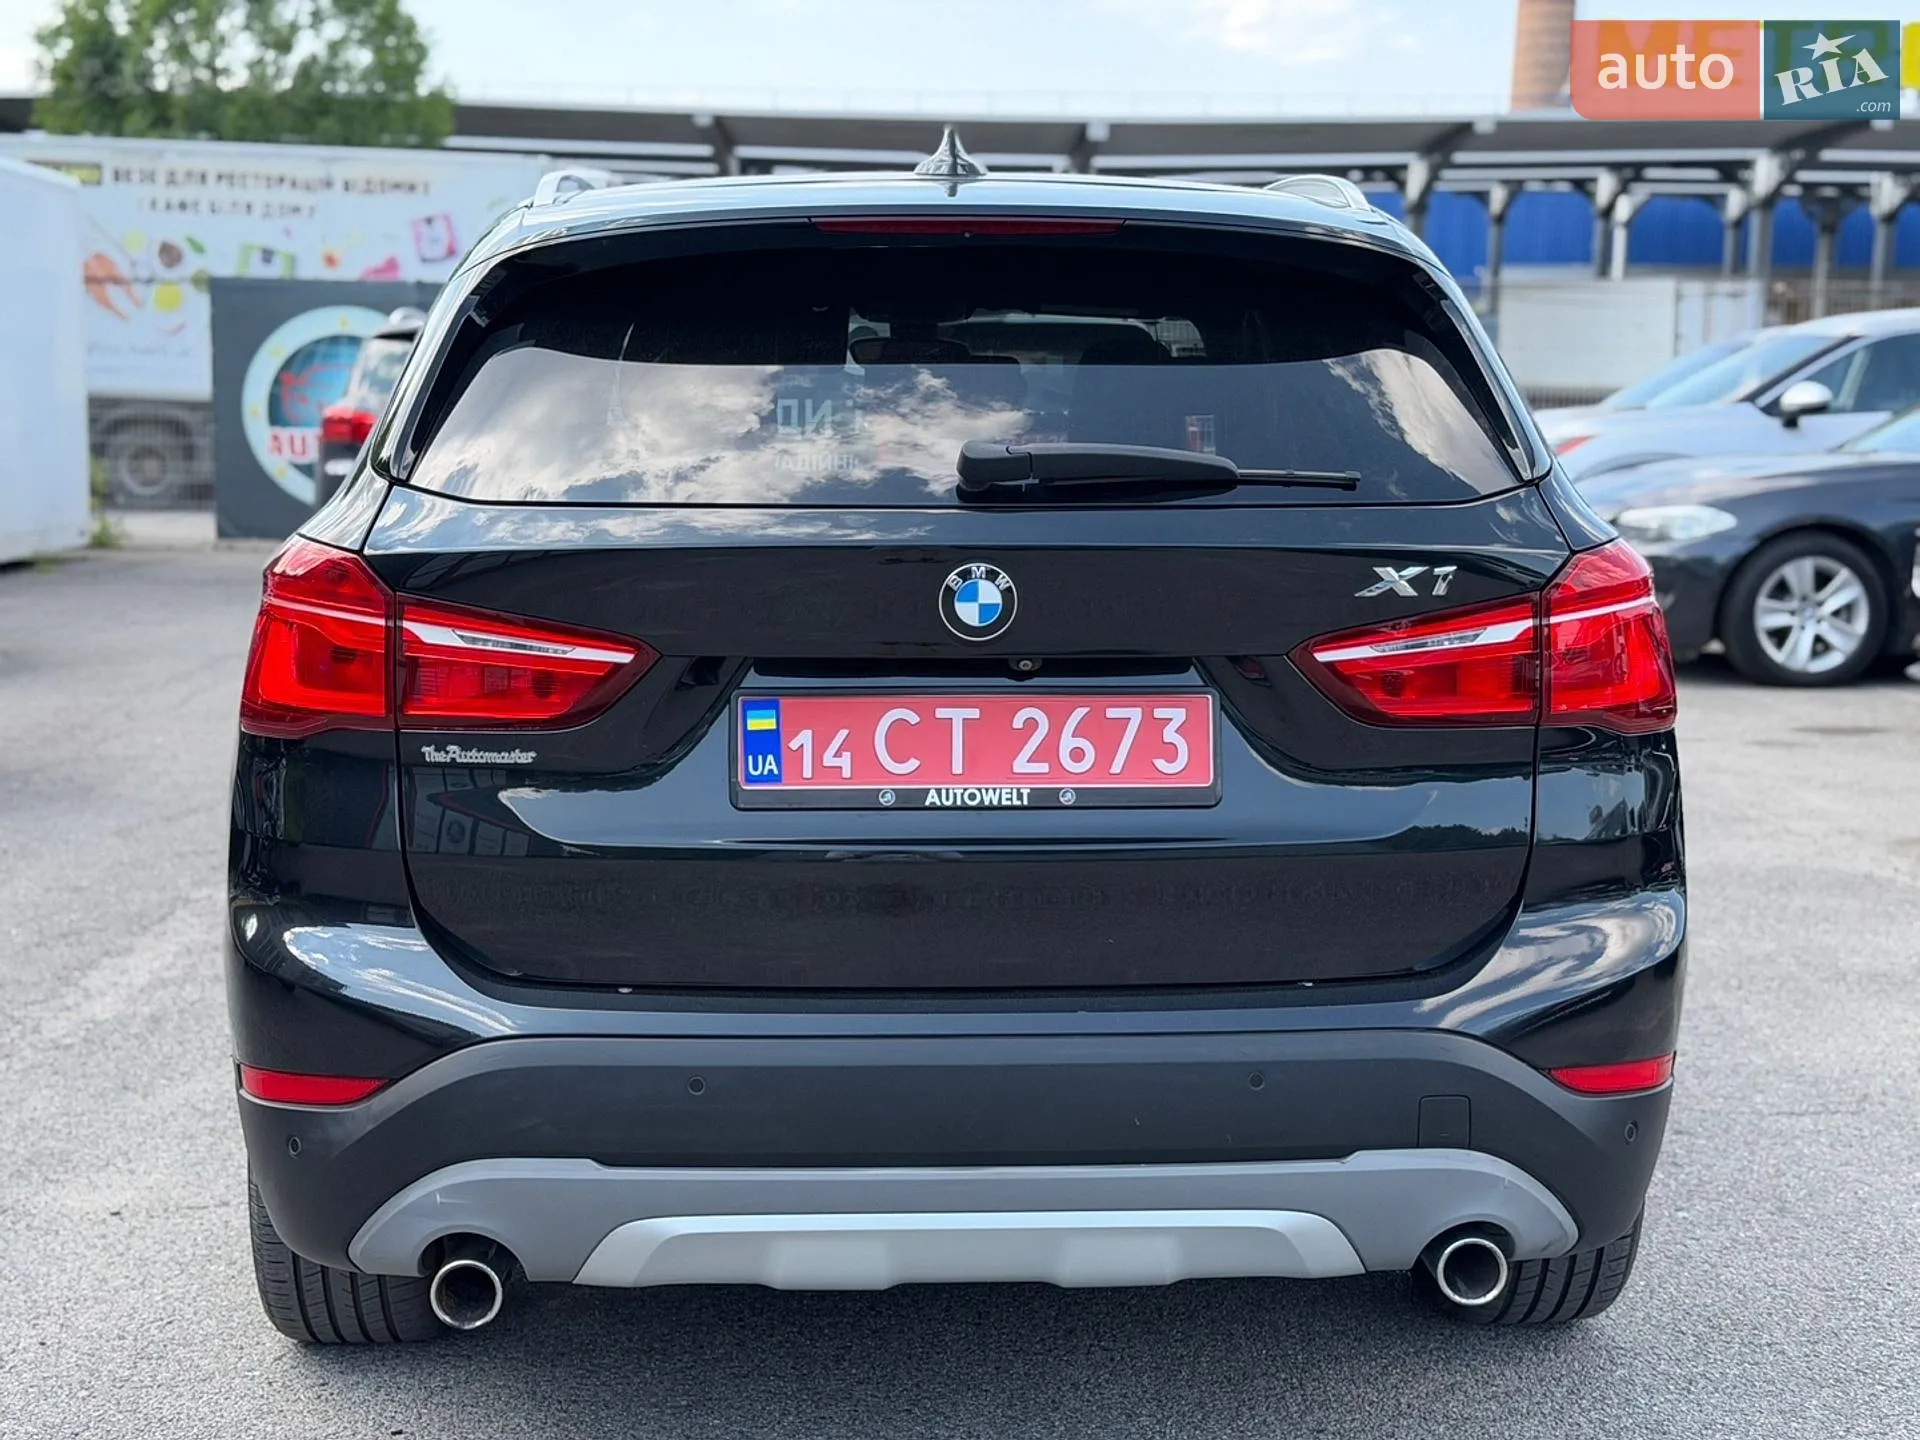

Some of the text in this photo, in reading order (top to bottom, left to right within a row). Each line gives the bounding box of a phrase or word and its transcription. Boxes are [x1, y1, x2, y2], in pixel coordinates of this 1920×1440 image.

[1596, 21, 1920, 90] METR
[945, 565, 1012, 591] BMW
[1354, 565, 1458, 597] X1
[747, 706, 1189, 780] UA 14 CT 2673
[924, 787, 1031, 807] AUTOWELT
